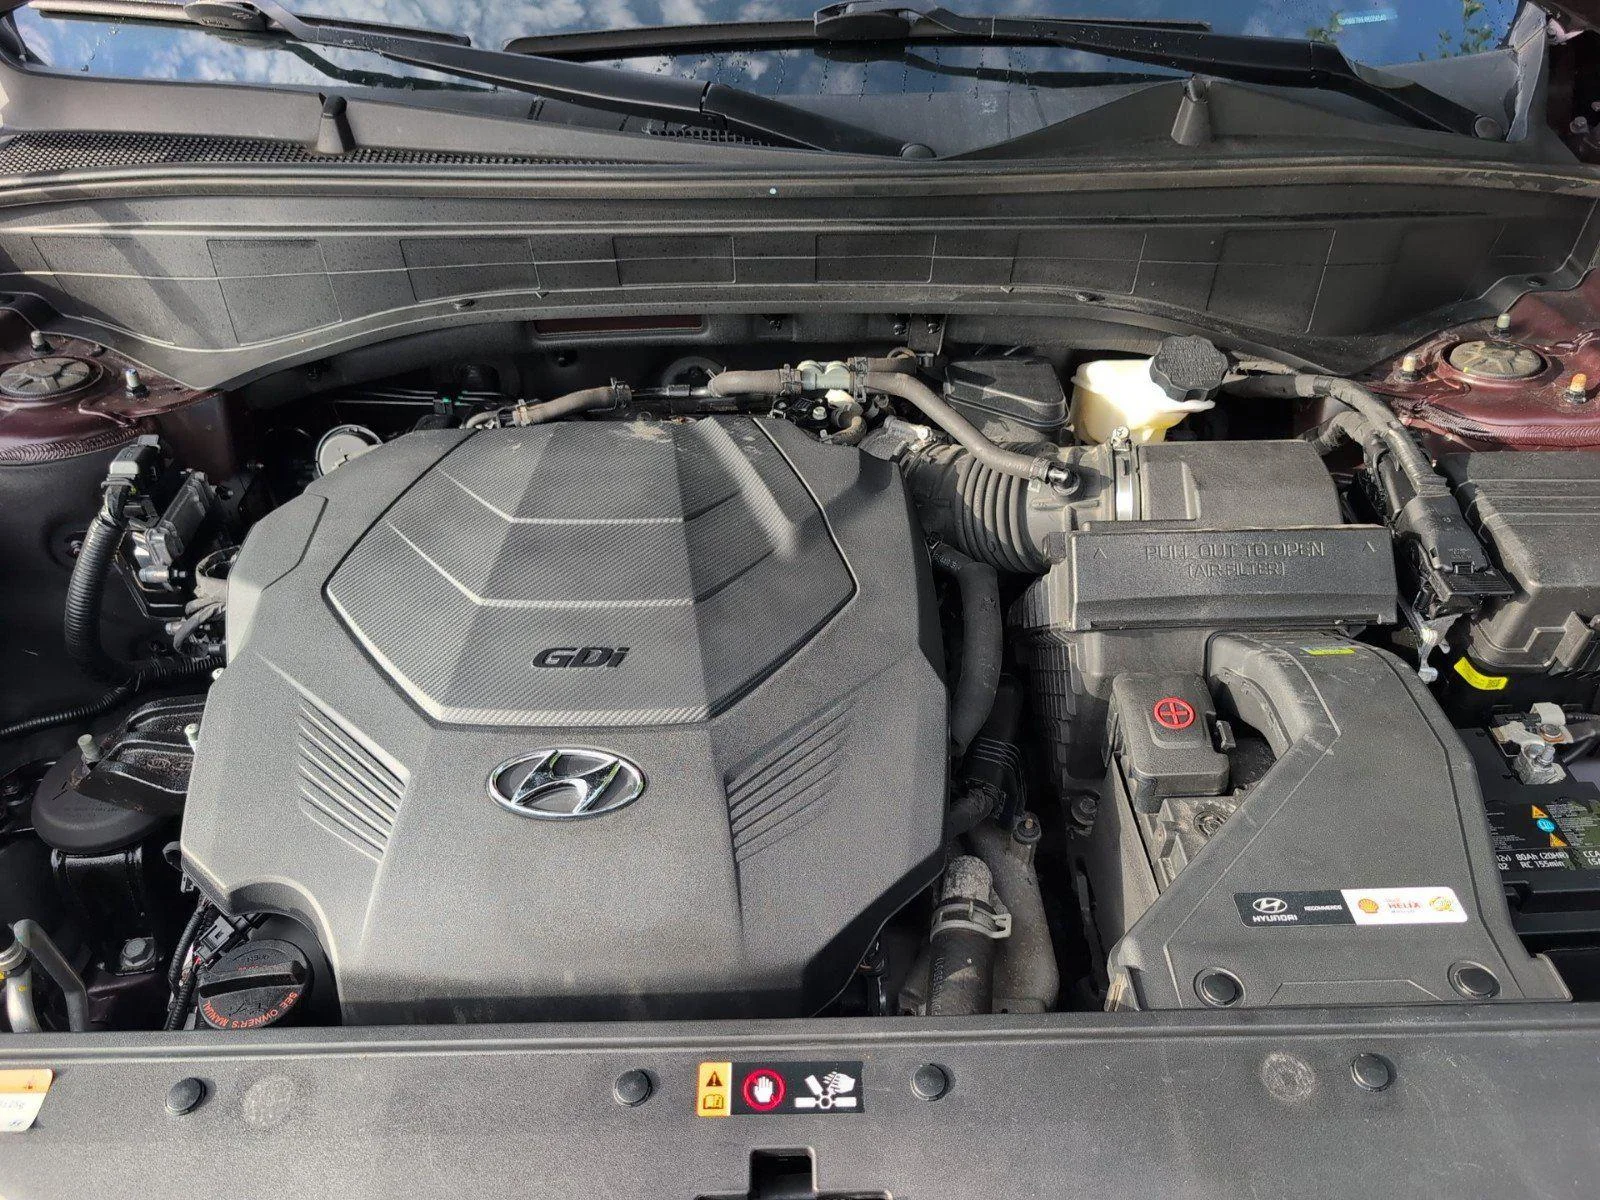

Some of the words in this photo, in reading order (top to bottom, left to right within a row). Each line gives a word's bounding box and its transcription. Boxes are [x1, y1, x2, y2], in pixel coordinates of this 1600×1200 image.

[1145, 544, 1193, 560] PULL
[1199, 543, 1237, 558] OUT
[1243, 542, 1268, 557] TO
[1273, 541, 1325, 557] OPEN
[532, 647, 630, 668] GDi
[1515, 853, 1538, 861] 80Ah
[1519, 861, 1534, 869] RC
[1252, 914, 1298, 922] HYUNDAI
[280, 991, 298, 1009] SEE
[202, 1000, 230, 1027] MANUAL
[231, 1008, 279, 1029] OWNER'S
